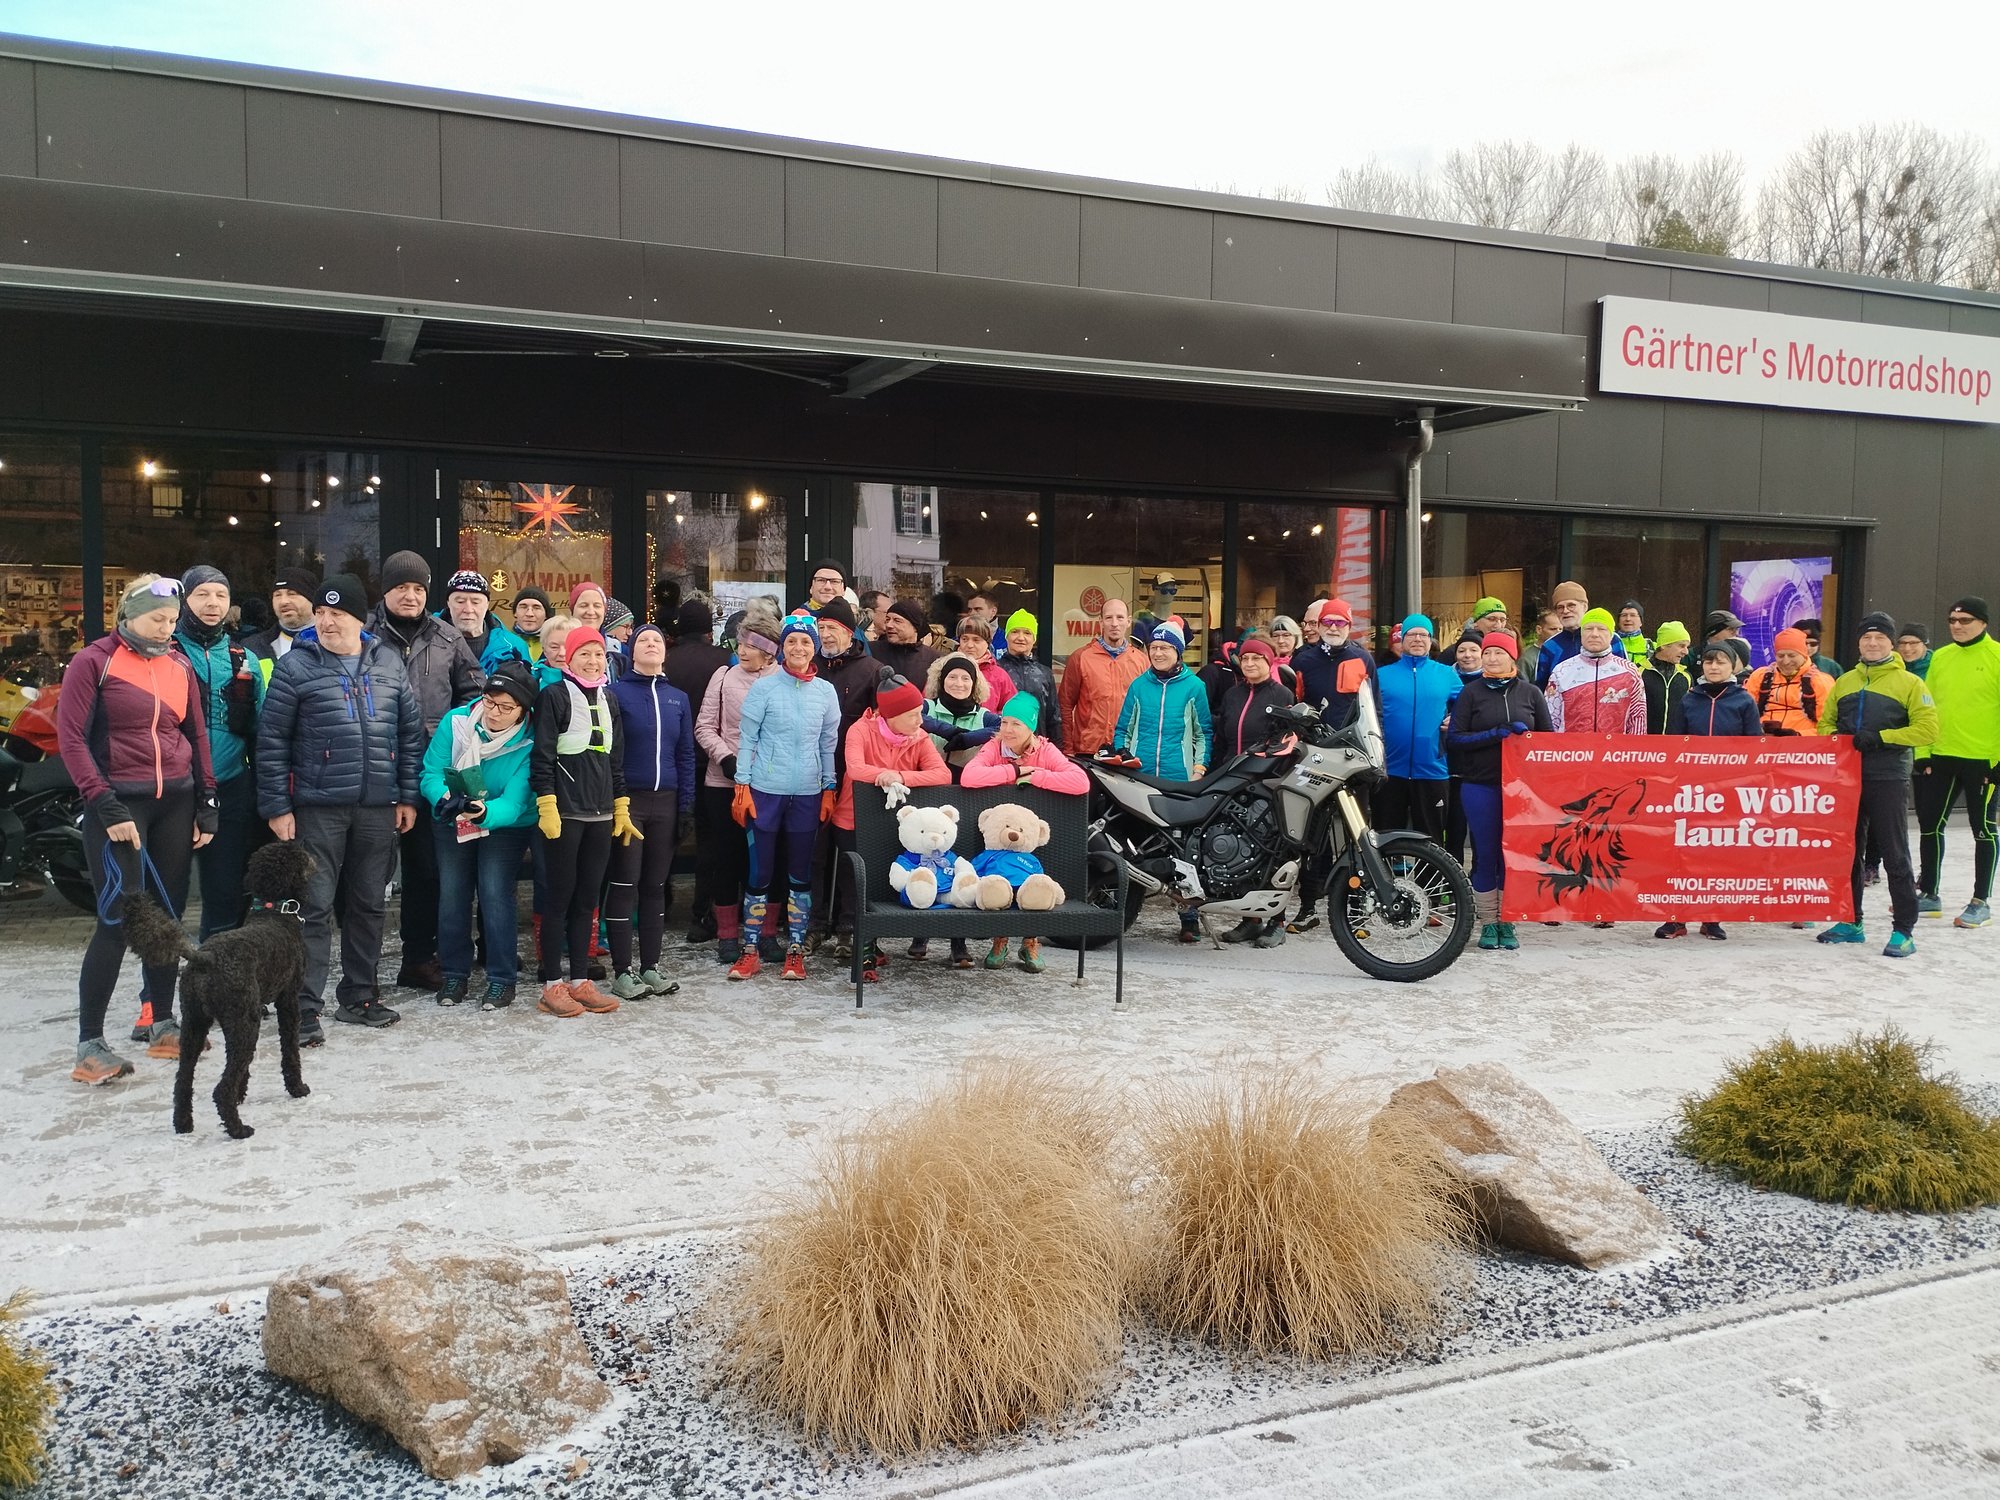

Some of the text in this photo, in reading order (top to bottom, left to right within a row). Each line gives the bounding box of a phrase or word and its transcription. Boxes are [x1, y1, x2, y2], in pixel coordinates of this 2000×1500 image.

[1621, 324, 1991, 405] Gärtner's Motorradshop
[1066, 620, 1104, 637] YAMA
[1525, 750, 1837, 765] ATENCION ACHTUNG ATTENTION ATTENZIONE
[1645, 784, 1836, 815] ...die Wölfe
[1674, 817, 1832, 848] laufen...
[1783, 877, 1829, 891] PIRNA
[1637, 893, 1830, 905] SENIORENLAUFGRUPPE des LSV Pirna
